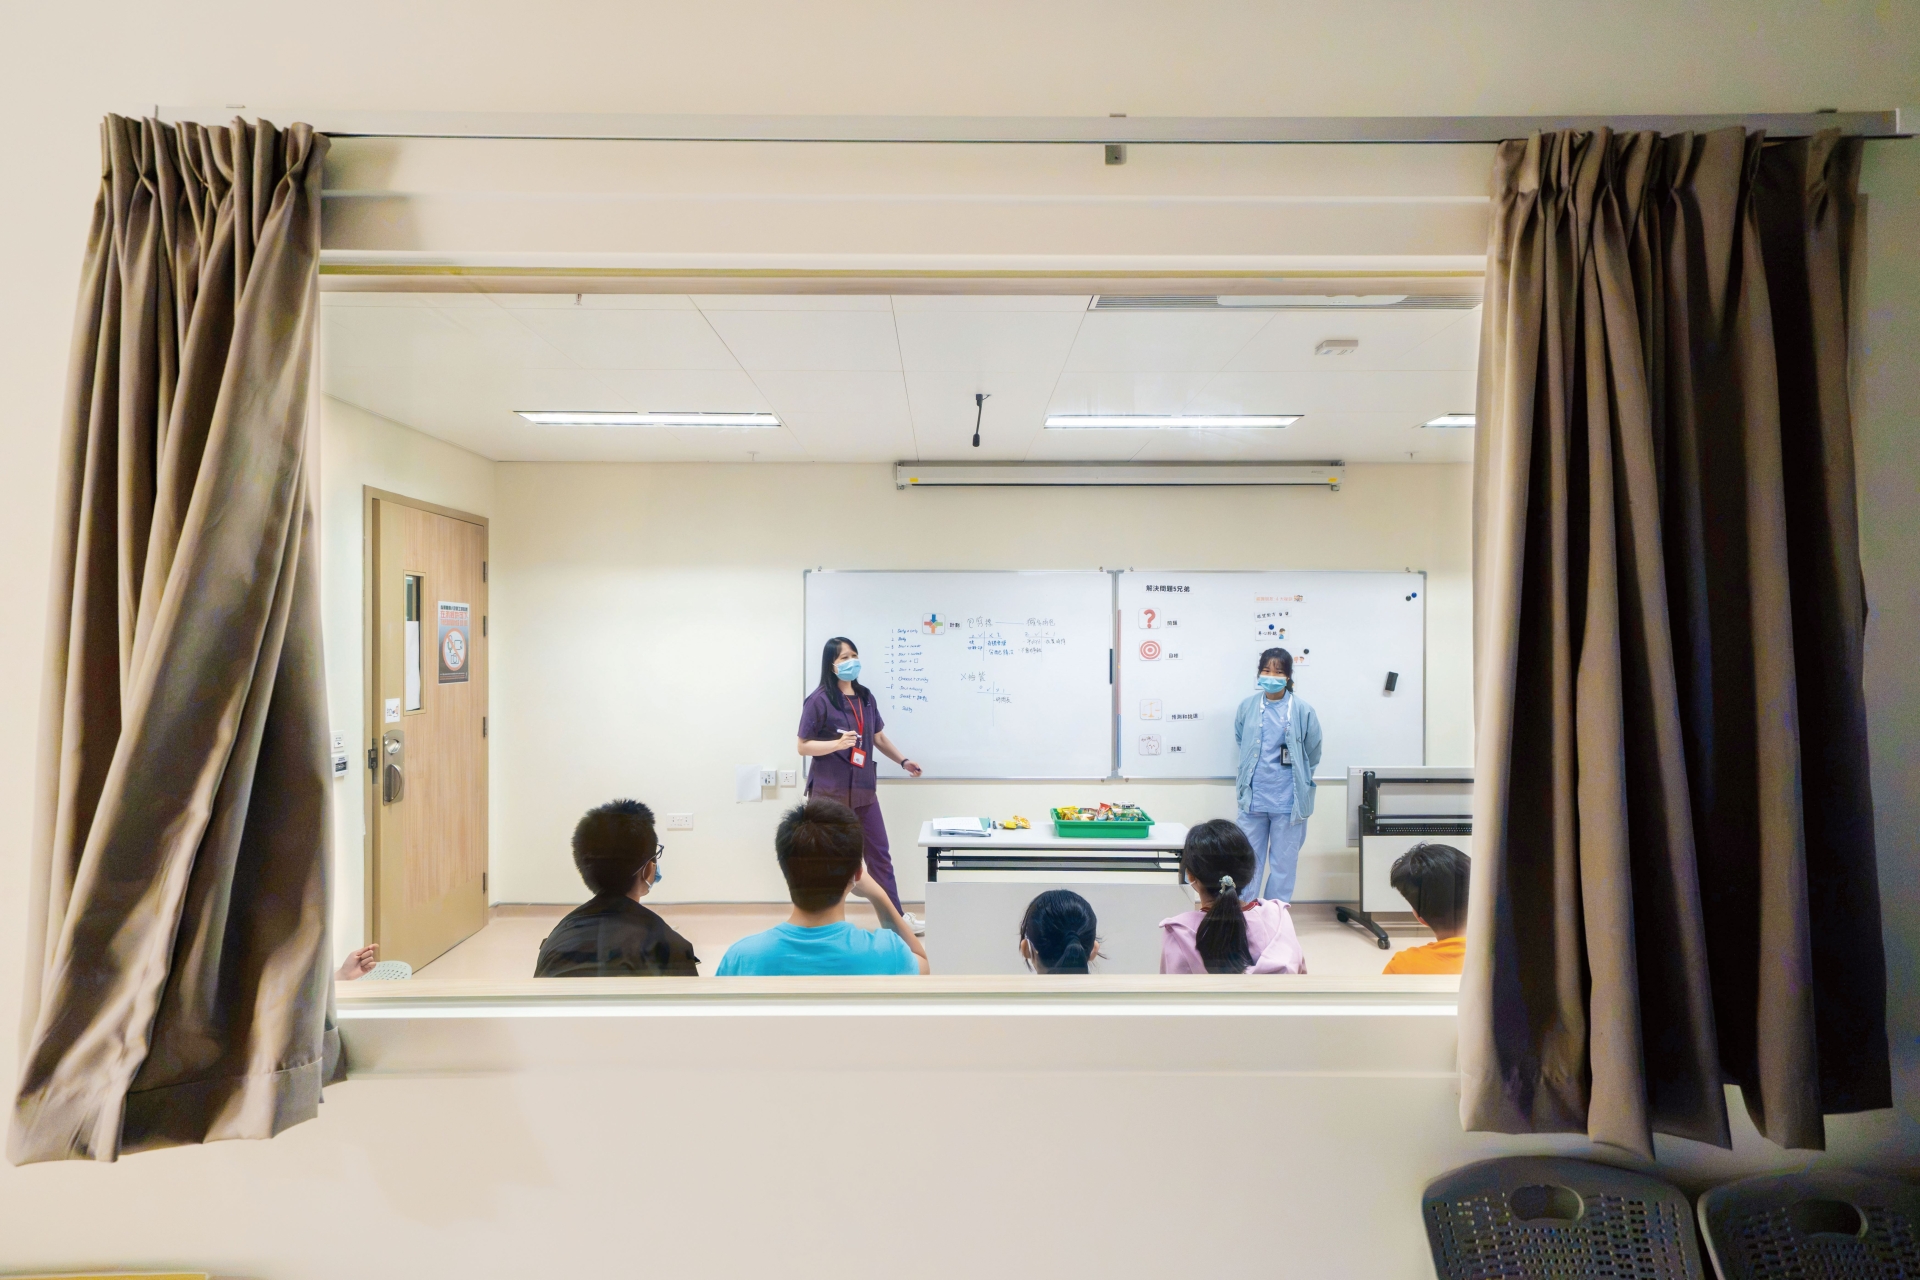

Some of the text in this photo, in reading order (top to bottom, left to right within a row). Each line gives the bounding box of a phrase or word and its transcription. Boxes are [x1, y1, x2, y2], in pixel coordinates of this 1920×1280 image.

[1145, 584, 1191, 593] 解決問題5兄弟
